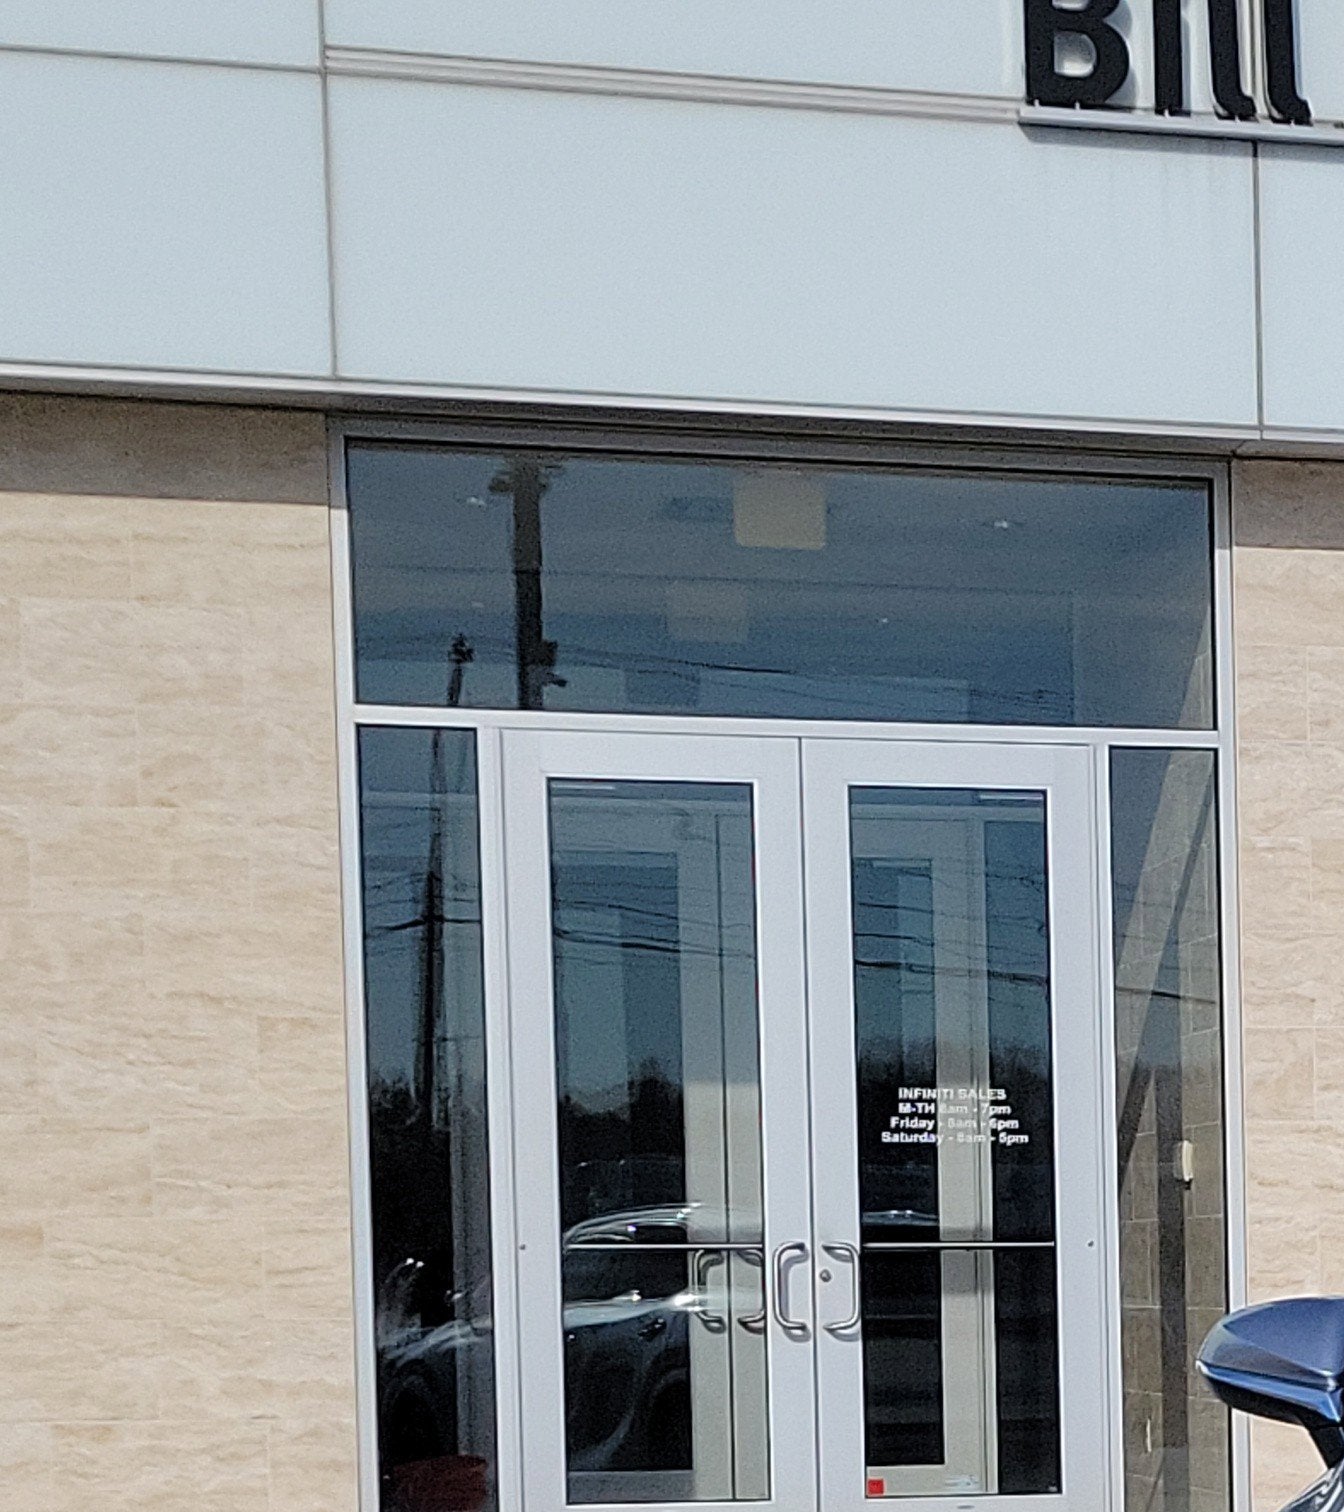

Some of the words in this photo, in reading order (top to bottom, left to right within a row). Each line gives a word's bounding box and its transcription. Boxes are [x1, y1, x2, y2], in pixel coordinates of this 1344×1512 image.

[1024, 0, 1313, 125] Bill
[898, 1087, 954, 1100] INFINITI
[958, 1088, 1007, 1100] SALES
[898, 1102, 935, 1114] M-TH
[981, 1102, 1012, 1118] 7pm
[890, 1115, 935, 1131] Friday
[881, 1131, 943, 1147] Saturday
